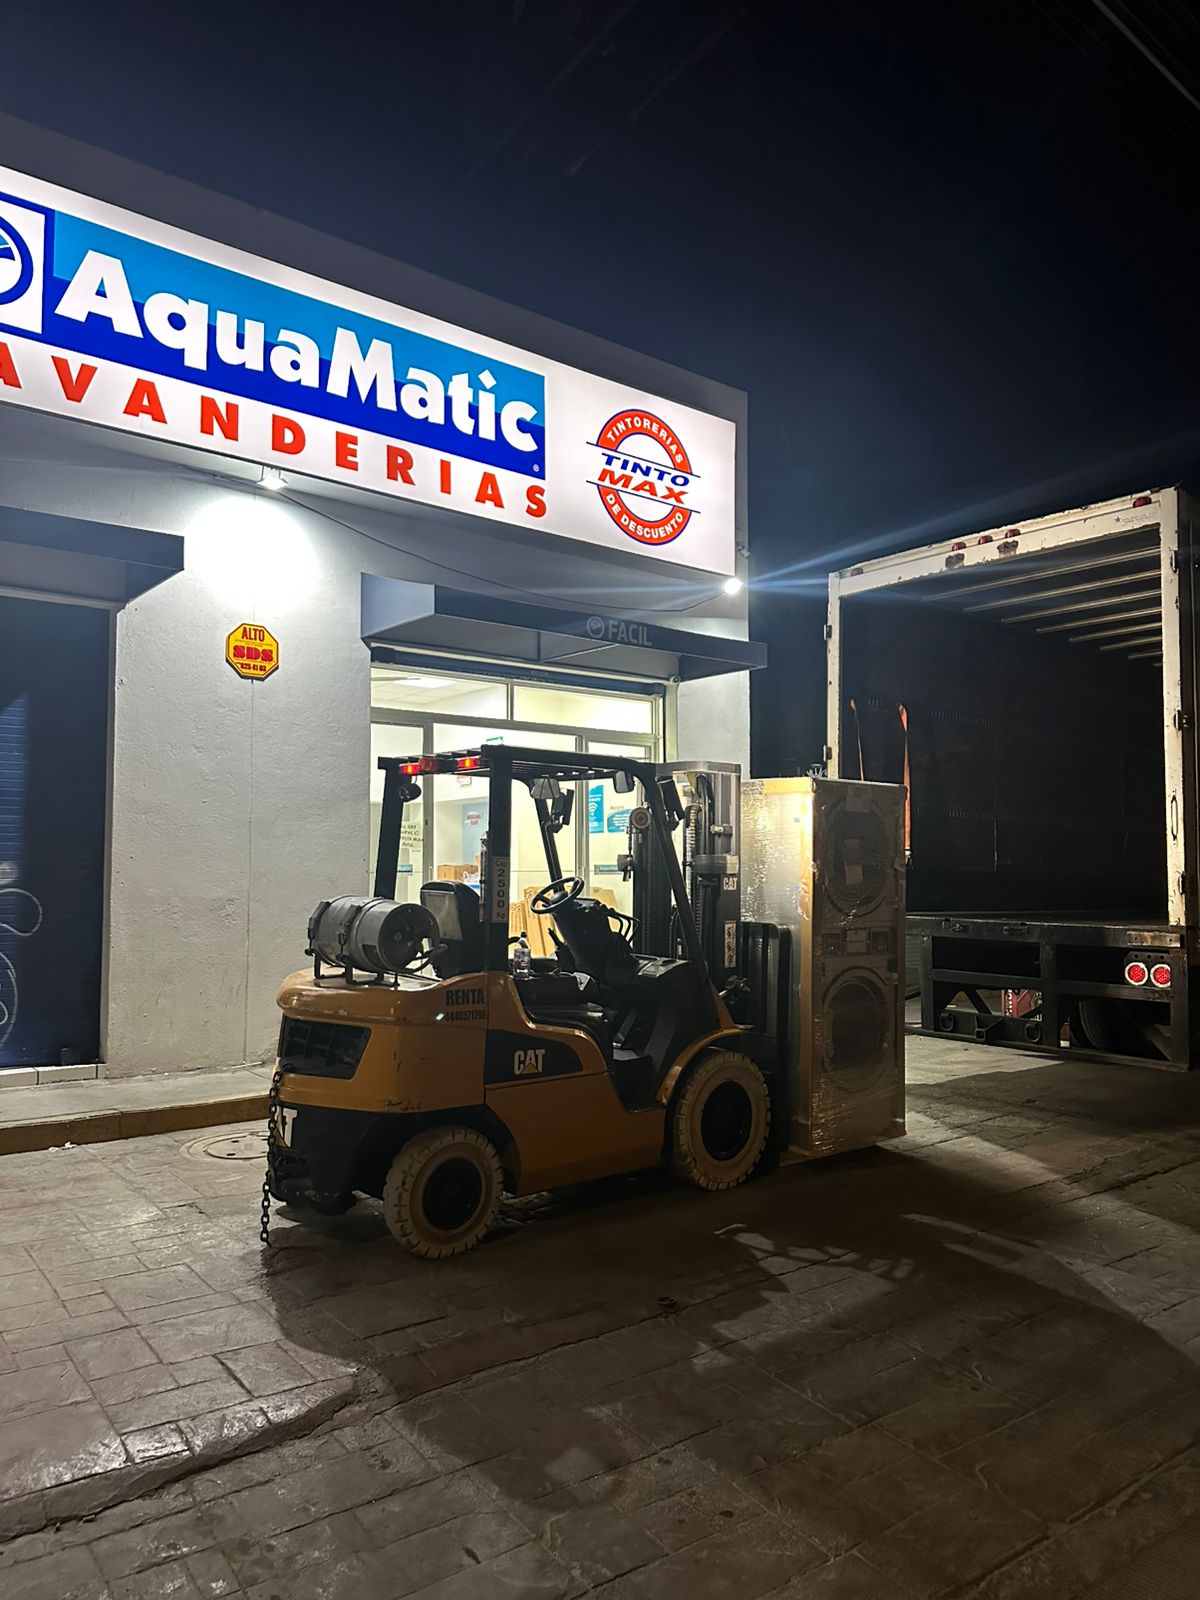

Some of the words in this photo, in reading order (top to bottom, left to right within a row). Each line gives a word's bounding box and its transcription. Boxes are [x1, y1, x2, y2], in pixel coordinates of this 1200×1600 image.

[55, 249, 539, 451] AquaMatic
[606, 416, 684, 463] TINTORERIAS
[602, 452, 690, 487] TINTO
[597, 468, 689, 505] MAX
[606, 493, 622, 515] DE
[621, 512, 683, 539] DESCUENTO
[241, 626, 265, 642] ALTO
[608, 620, 652, 646] FACIL
[233, 645, 273, 662] SDS
[497, 869, 506, 909] 2500
[723, 877, 738, 891] CAT
[446, 989, 485, 1006] RENTA
[514, 1049, 545, 1075] CAT
